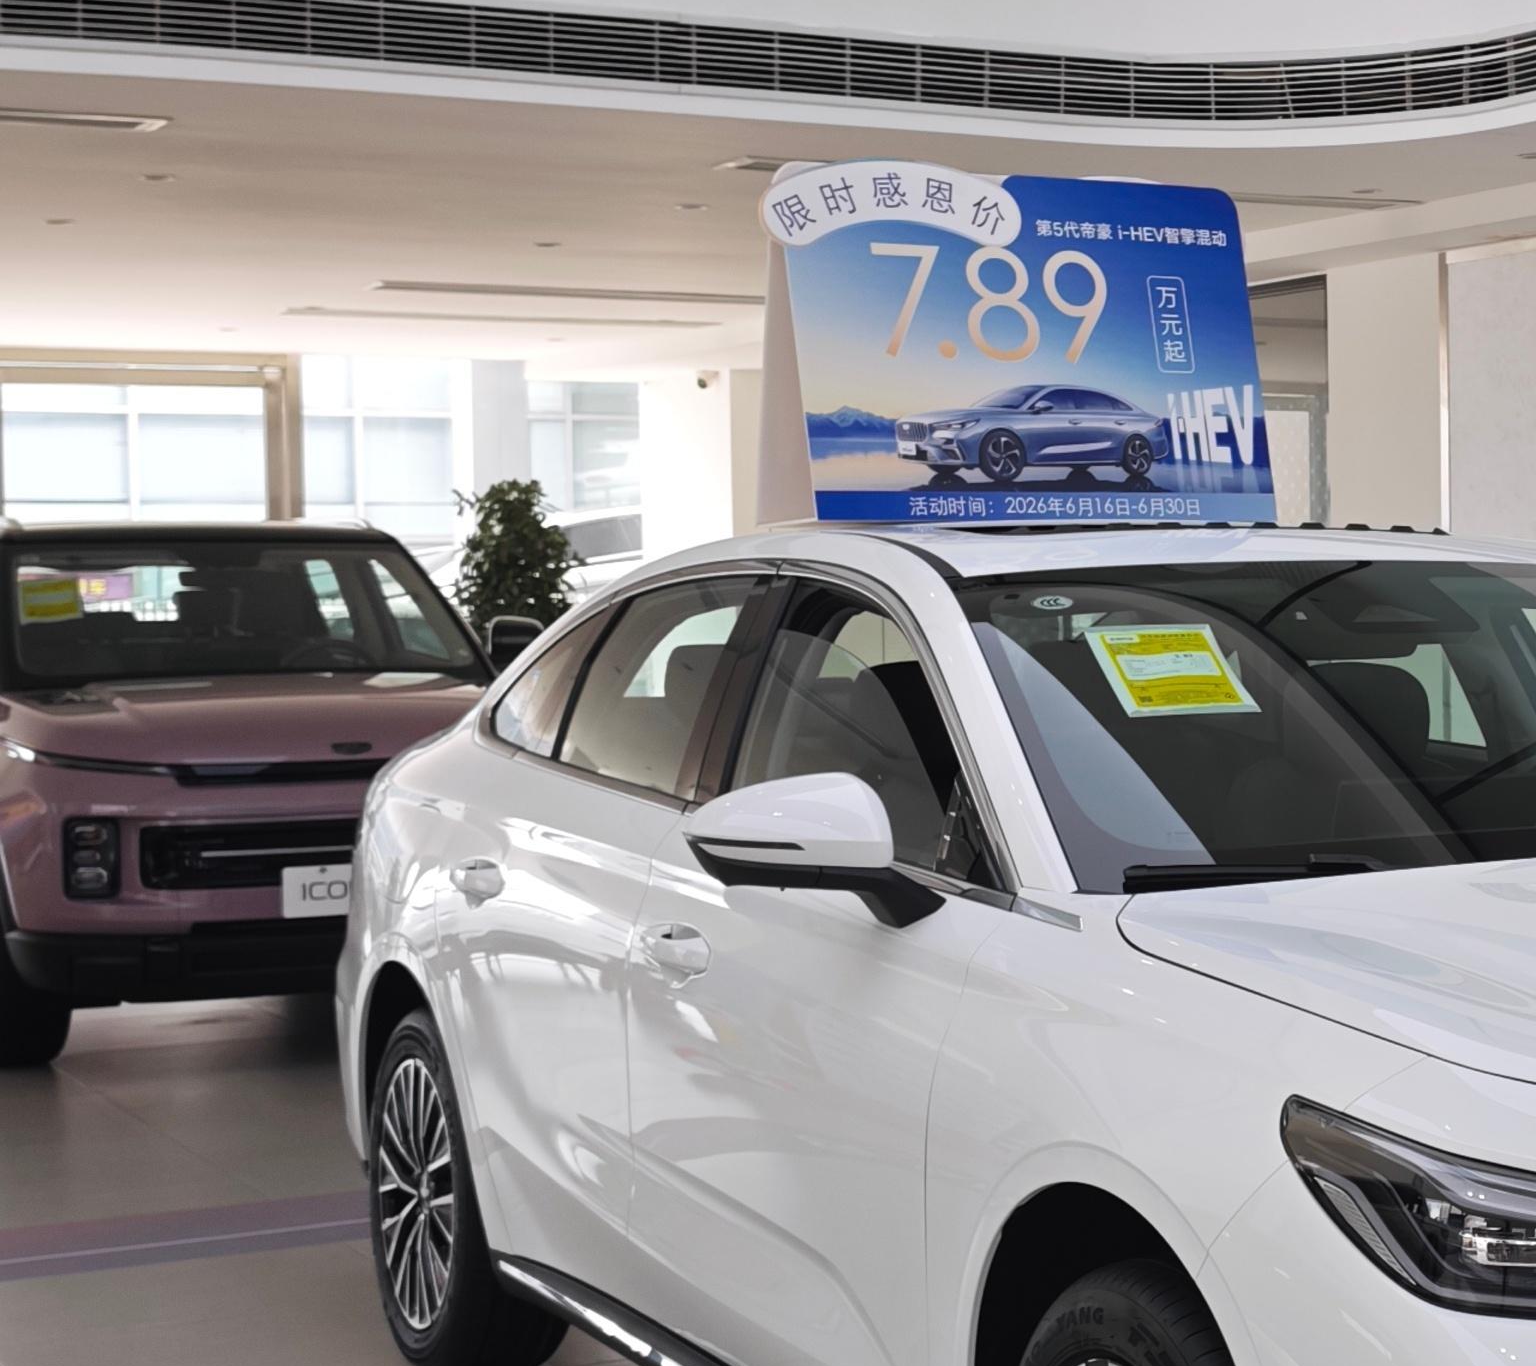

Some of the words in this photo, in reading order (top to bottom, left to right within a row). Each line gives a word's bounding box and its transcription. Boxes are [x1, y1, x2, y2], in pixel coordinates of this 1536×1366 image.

[771, 172, 1006, 237] 限时感恩价
[1035, 219, 1114, 241] 第5代帝豪
[1117, 224, 1228, 247] i-HEV智擎混动
[869, 241, 1108, 365] 7.89
[1154, 285, 1188, 363] 万元起
[301, 879, 352, 902] ICO
